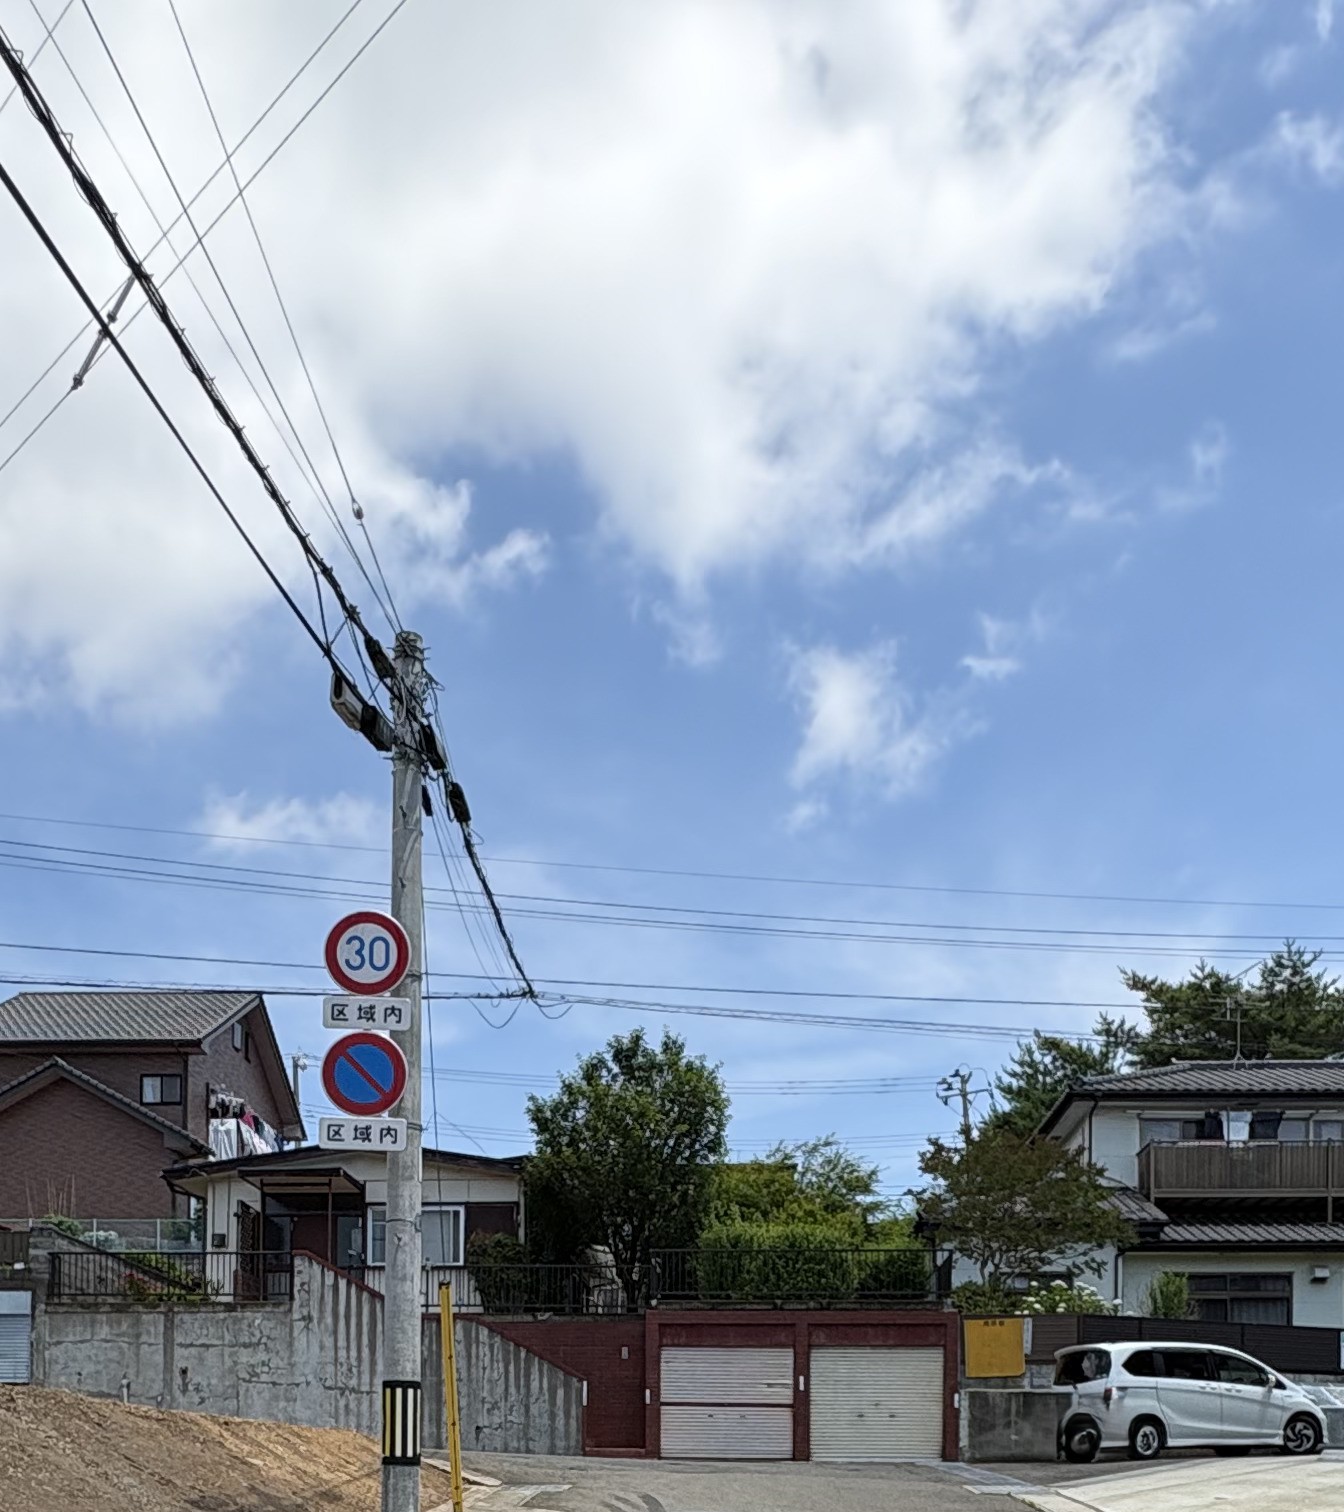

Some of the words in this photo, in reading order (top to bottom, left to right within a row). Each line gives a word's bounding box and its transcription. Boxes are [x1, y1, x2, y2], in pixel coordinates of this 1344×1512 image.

[344, 935, 390, 972] 30
[330, 1003, 402, 1026] 区域内
[327, 1124, 398, 1145] 区域内
